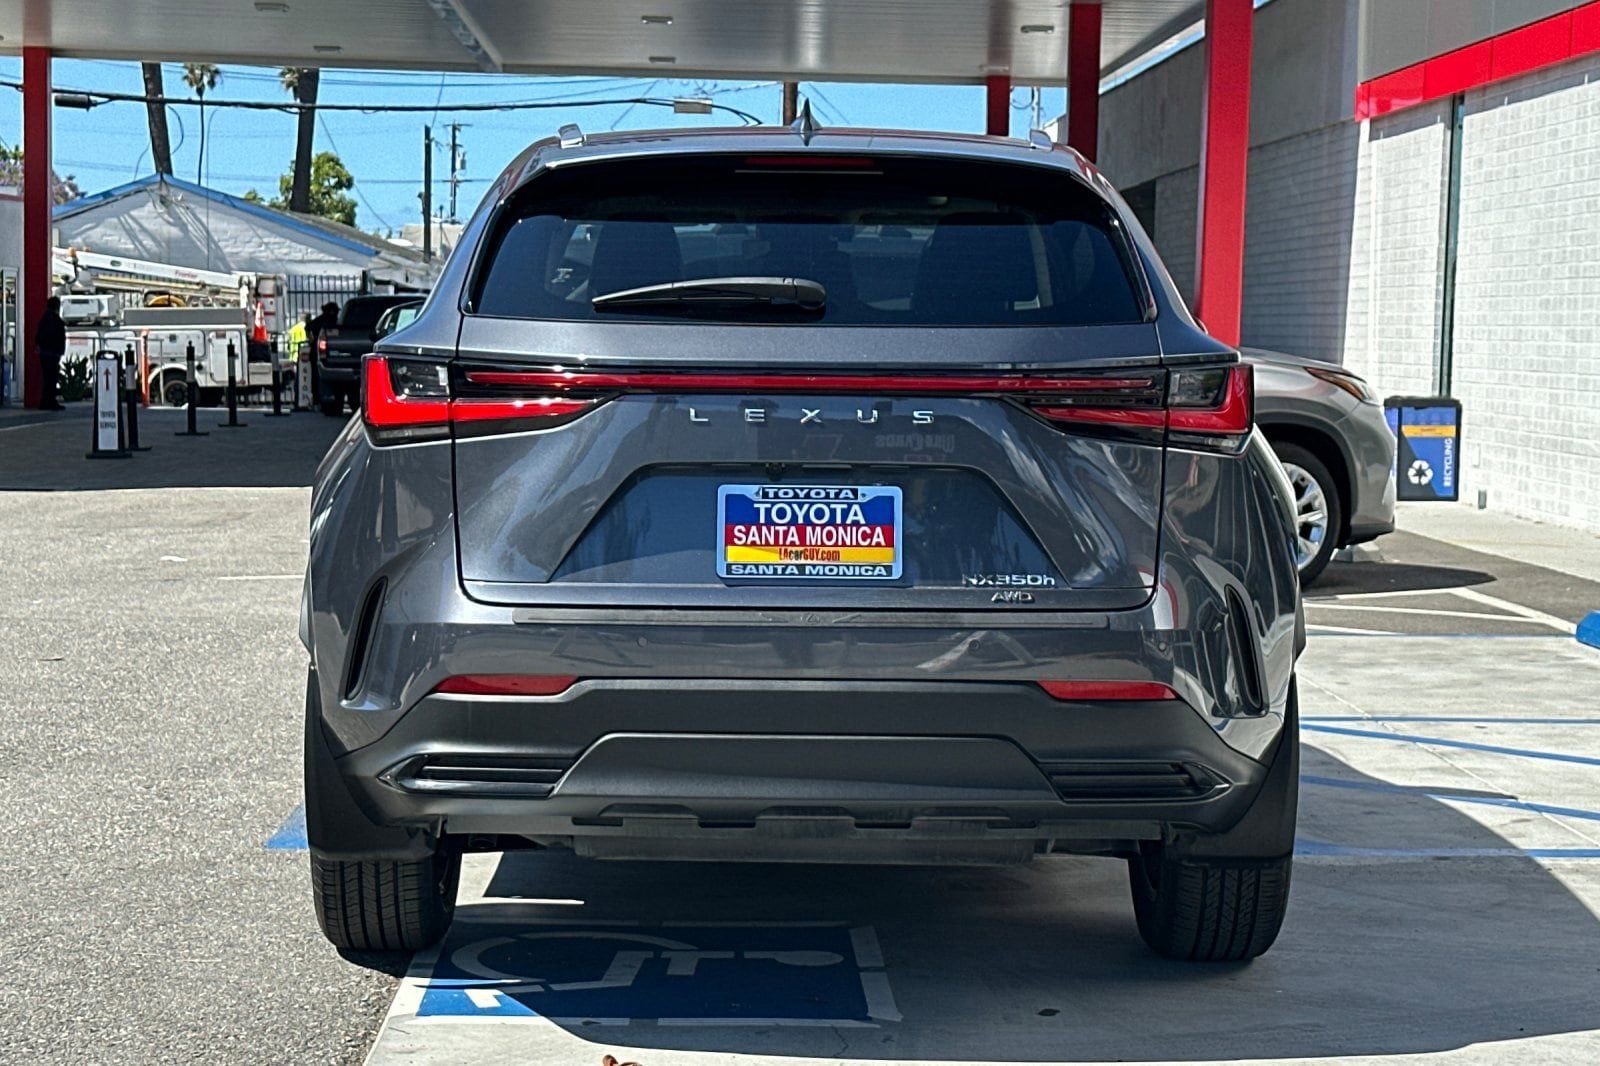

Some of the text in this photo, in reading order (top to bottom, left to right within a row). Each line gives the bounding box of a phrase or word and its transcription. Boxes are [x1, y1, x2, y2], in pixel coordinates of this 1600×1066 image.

[689, 407, 935, 424] LEXUS
[1443, 437, 1453, 487] RECYCLING
[764, 488, 855, 499] TOYOTA
[753, 503, 866, 525] TOYOTA
[733, 525, 886, 546] SANTA MONICA
[731, 565, 887, 576] SANTA MONICA
[991, 591, 1033, 602] AWD
